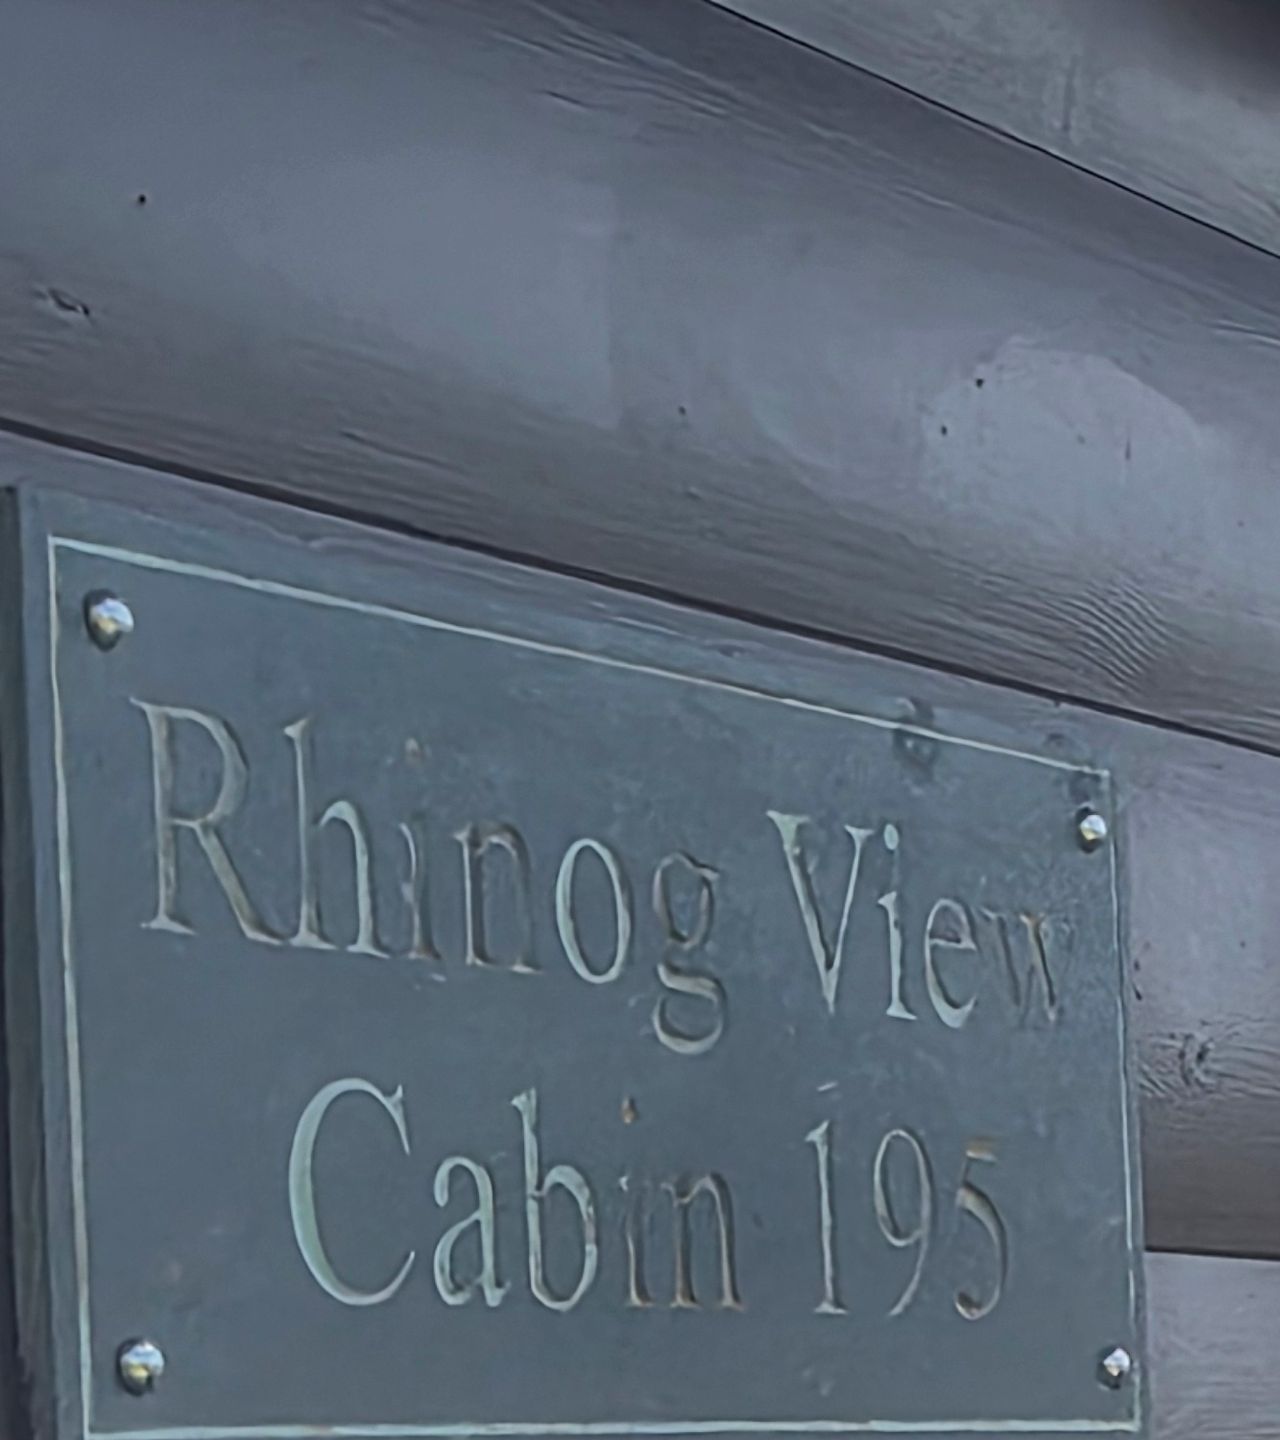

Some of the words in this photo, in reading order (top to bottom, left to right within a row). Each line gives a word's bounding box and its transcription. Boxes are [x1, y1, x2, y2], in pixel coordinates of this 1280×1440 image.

[129, 696, 726, 1053] Rhinog
[767, 810, 1069, 1026] View
[288, 1076, 742, 1311] Cabin
[804, 1119, 1010, 1320] 195
